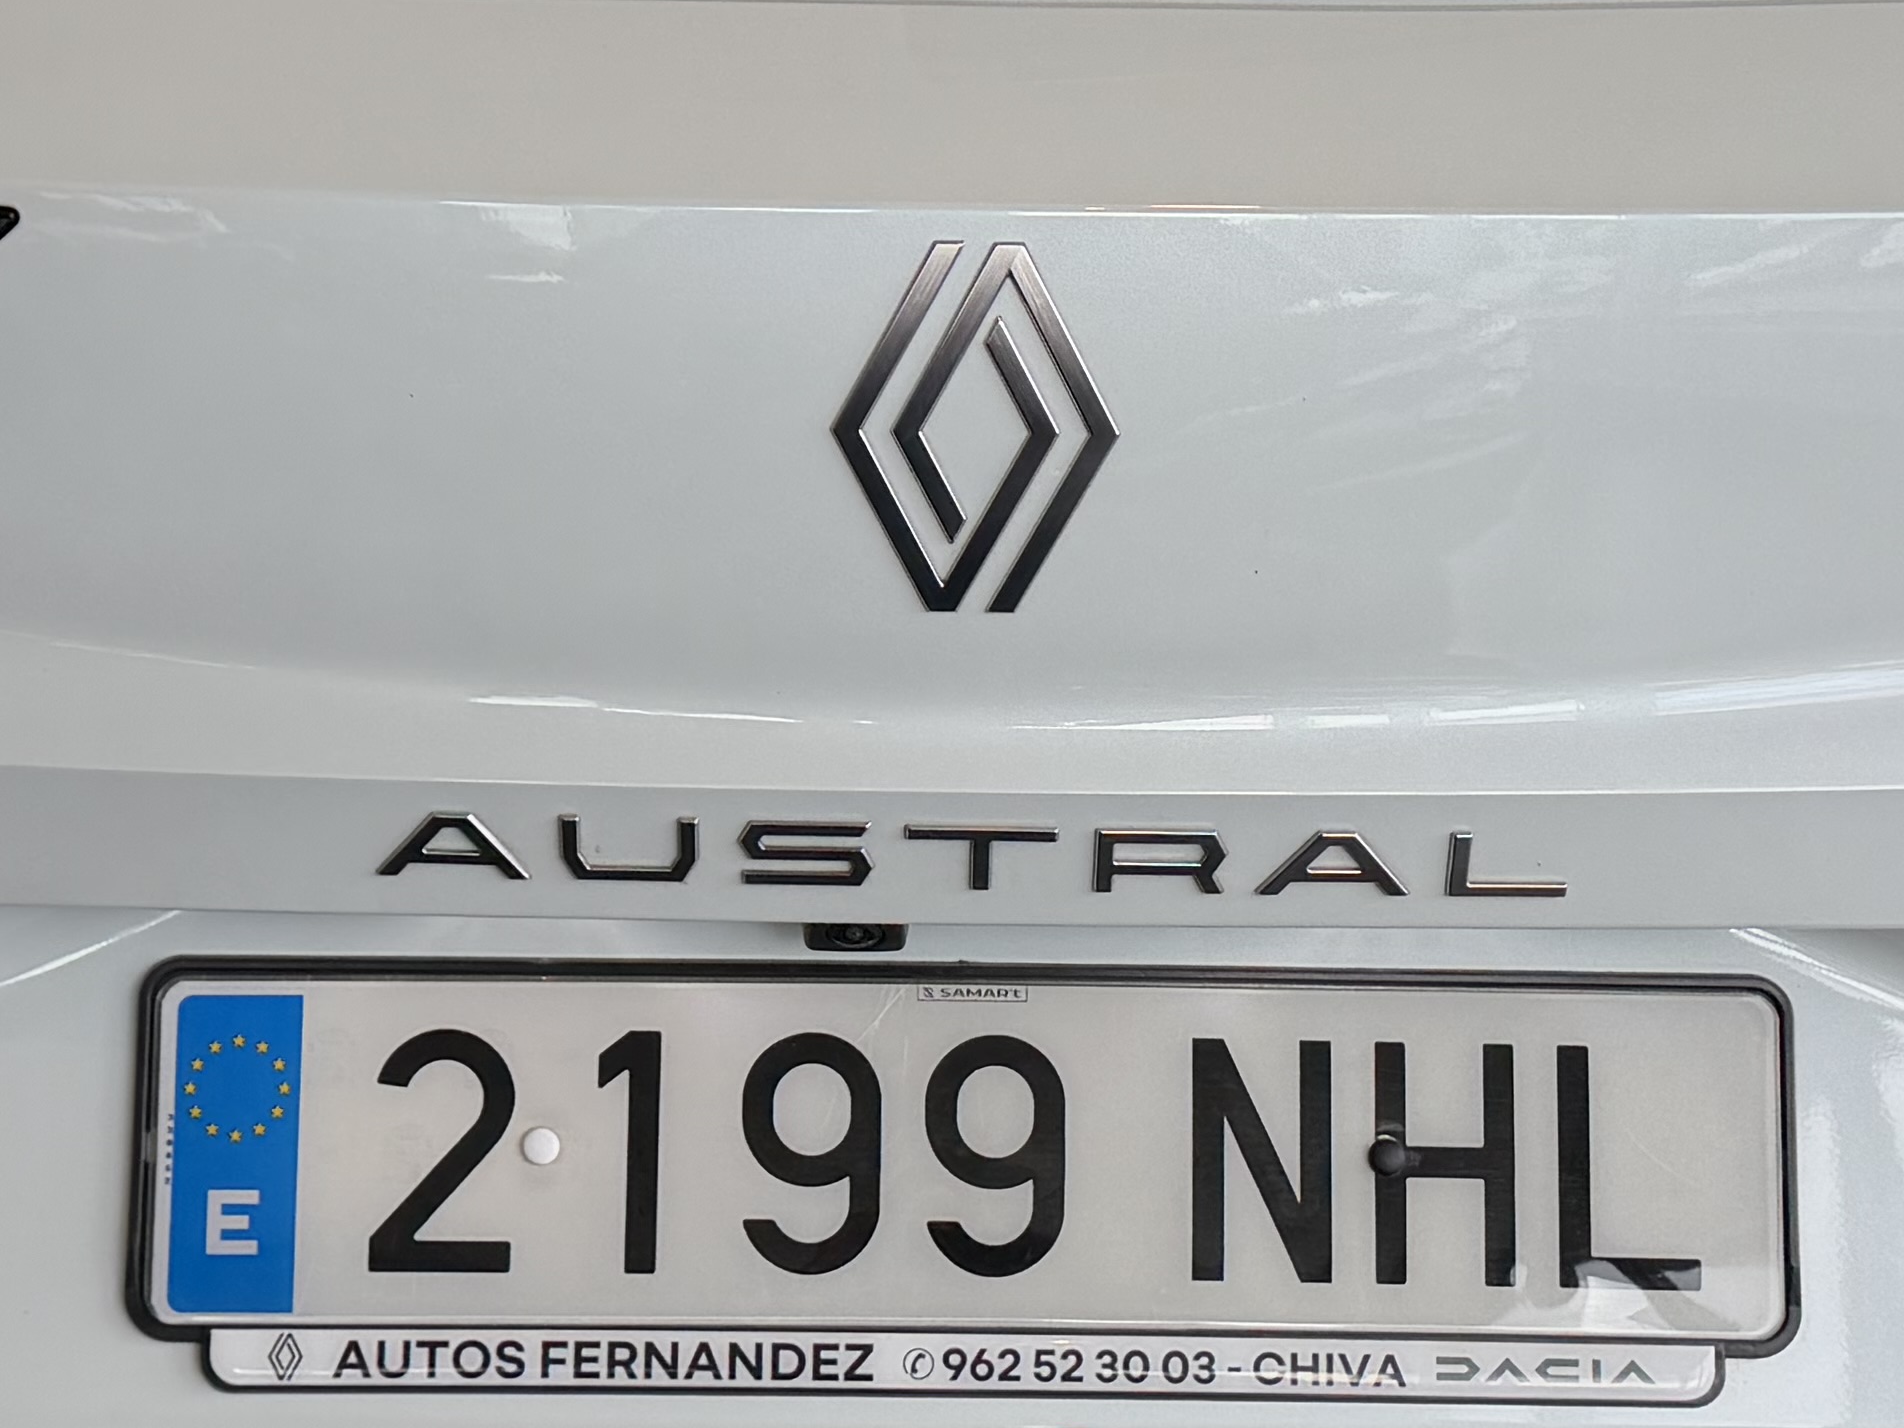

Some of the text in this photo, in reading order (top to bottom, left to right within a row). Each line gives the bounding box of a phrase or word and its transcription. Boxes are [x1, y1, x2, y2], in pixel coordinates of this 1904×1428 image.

[375, 811, 1568, 899] AUSTRAL
[367, 1028, 1703, 1291] 2199 NHL
[206, 1189, 260, 1255] E
[332, 1339, 526, 1380] AUTOS
[540, 1340, 875, 1382] FERNANDEZ
[942, 1347, 1022, 1382] 962
[1033, 1348, 1084, 1383] 52
[1095, 1349, 1151, 1384] 30
[1161, 1350, 1217, 1385] 03
[1252, 1351, 1407, 1388] CHIVA
[1435, 1356, 1656, 1385] DACIA
